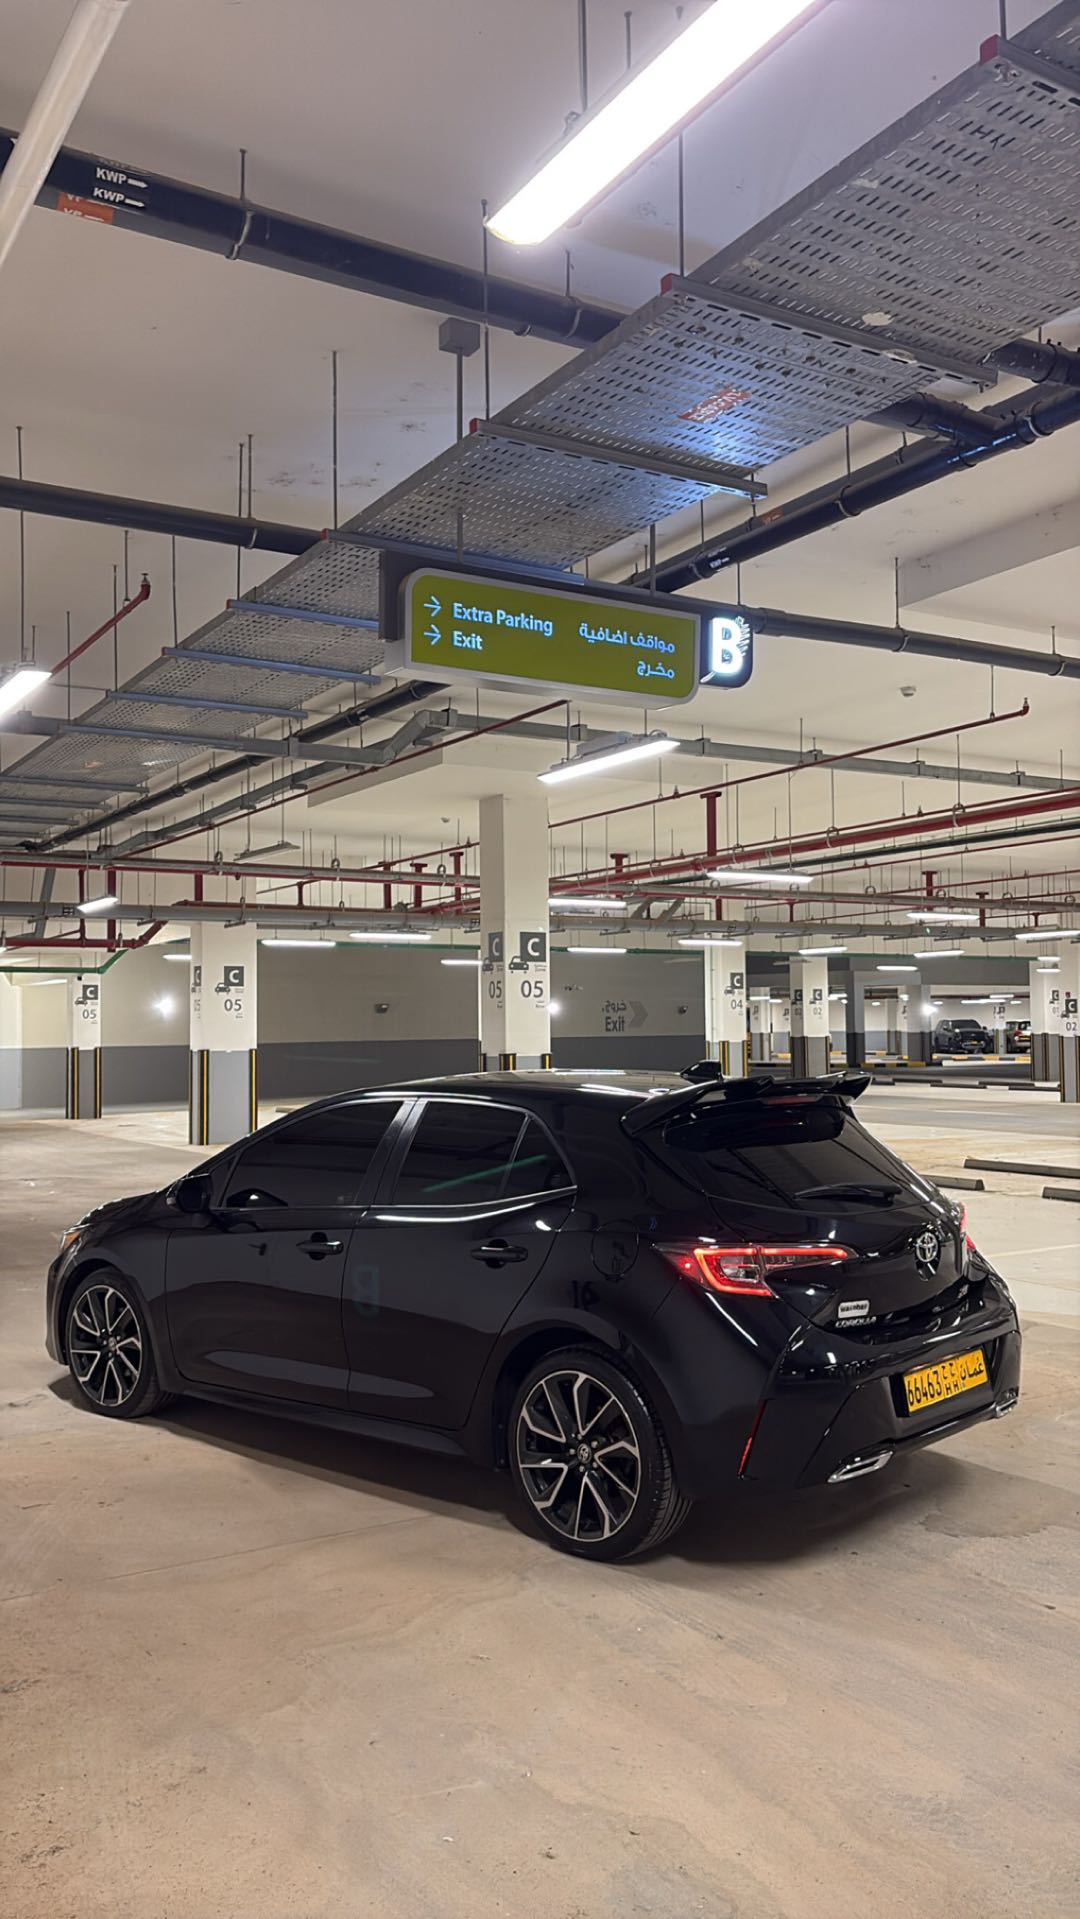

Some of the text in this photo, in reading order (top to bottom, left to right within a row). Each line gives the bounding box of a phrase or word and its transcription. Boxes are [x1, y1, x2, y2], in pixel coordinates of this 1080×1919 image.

[96, 167, 127, 185] KWP
[93, 187, 125, 203] KWP
[453, 603, 553, 636] Extra Parking
[453, 630, 483, 650] Exit
[579, 623, 675, 654] مواقف اضافية
[710, 617, 744, 673] B
[636, 660, 675, 679] مخرج
[492, 938, 500, 956] C
[527, 937, 540, 956] C
[229, 969, 240, 984] C
[733, 975, 741, 987] C
[86, 987, 95, 998] C
[489, 980, 502, 999] 05
[520, 980, 544, 998] 05
[224, 998, 242, 1012] 05
[730, 999, 743, 1010] 04
[1068, 1001, 1076, 1011] C
[82, 1008, 97, 1020] 05
[605, 1016, 625, 1032] Exit
[1066, 1021, 1077, 1032] 02
[907, 1370, 942, 1406] 66463
